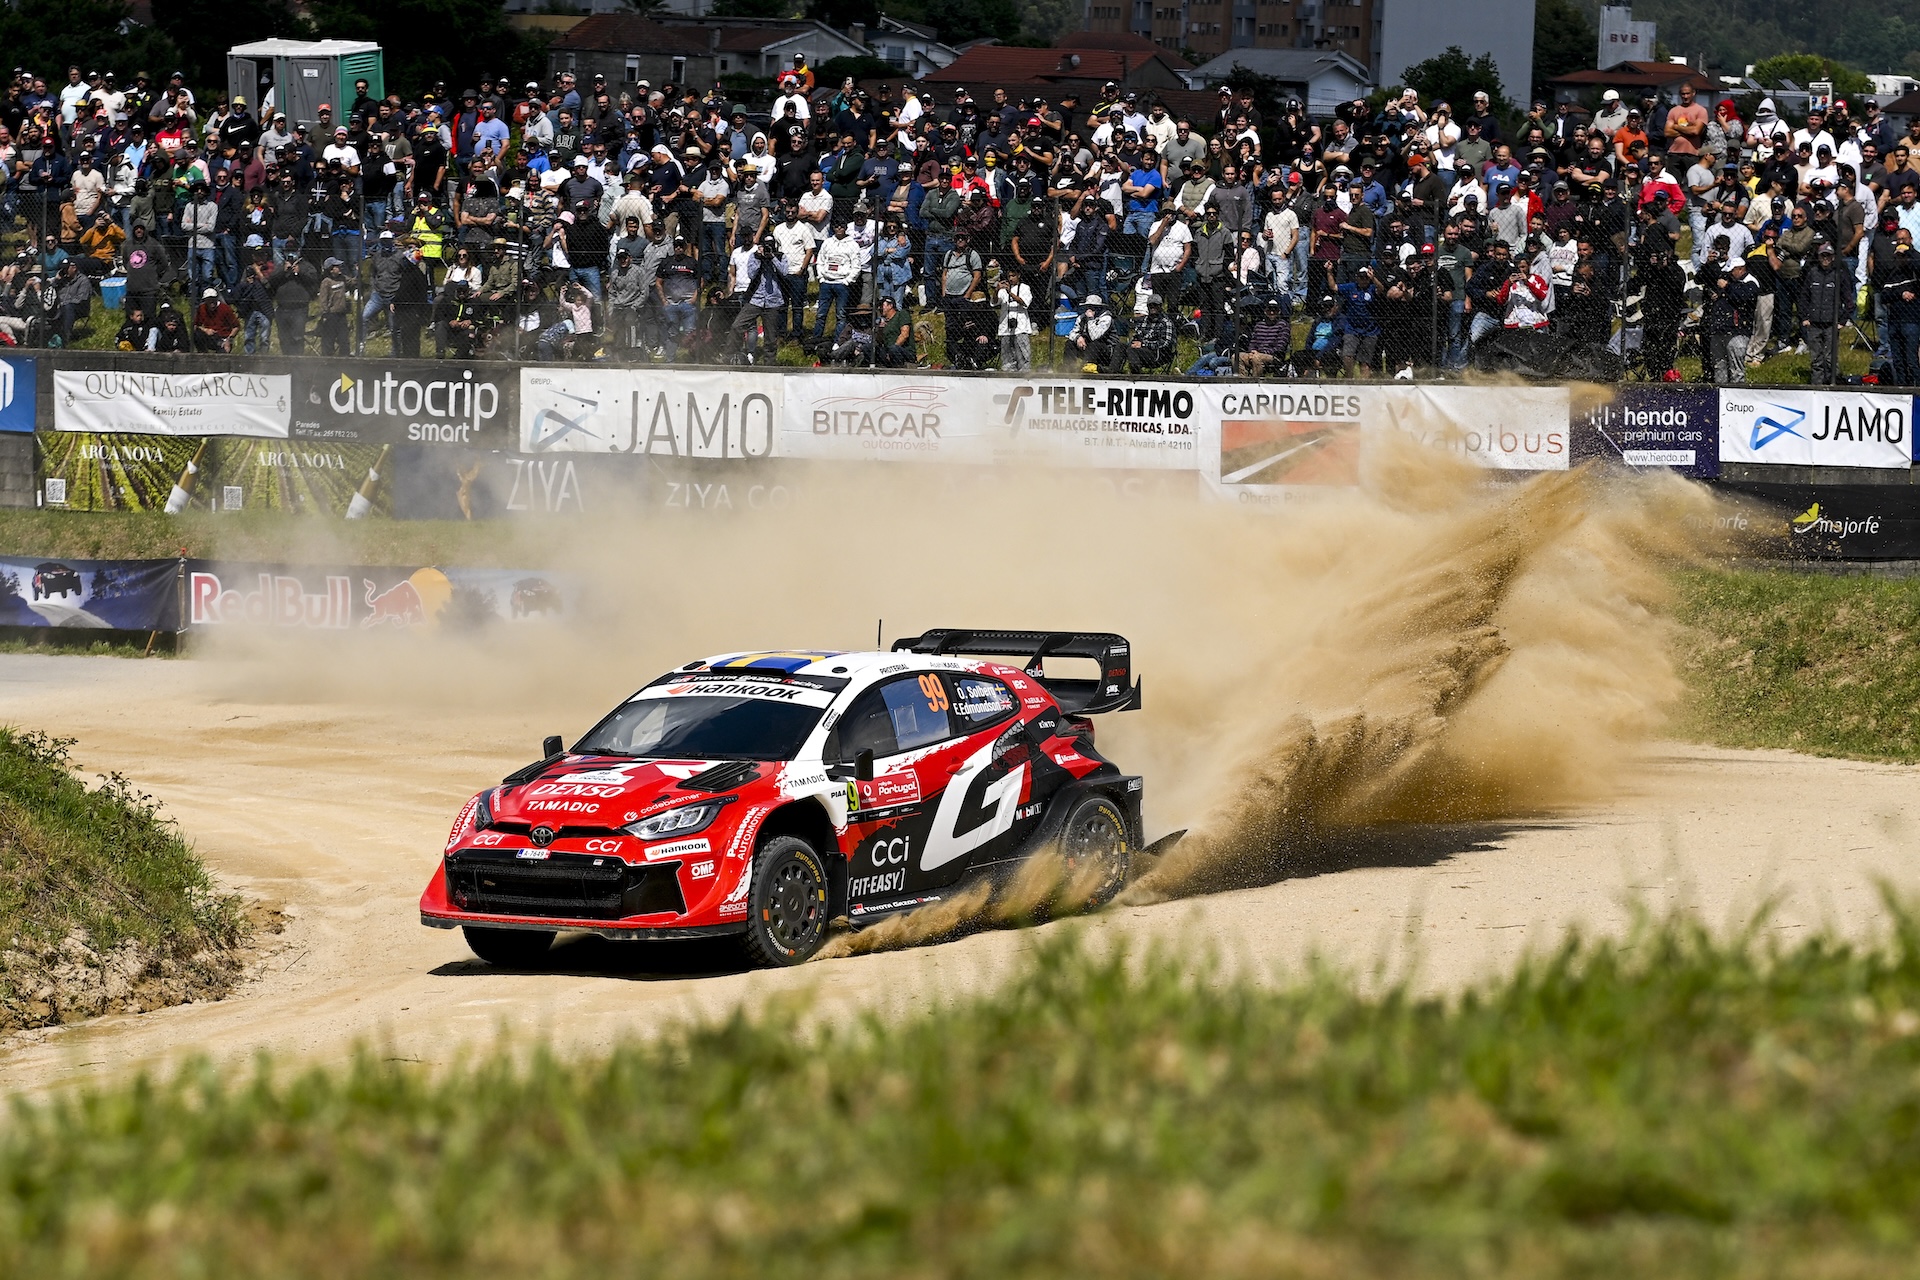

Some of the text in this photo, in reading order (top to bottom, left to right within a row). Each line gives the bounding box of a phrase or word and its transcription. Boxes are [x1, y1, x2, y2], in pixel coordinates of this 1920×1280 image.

[1610, 33, 1639, 43] BVB
[1491, 174, 1510, 182] FILA
[199, 375, 269, 398] ARCAS
[329, 369, 499, 431] autocrip
[1037, 386, 1194, 419] TELE-RITMO
[1221, 393, 1361, 417] CARIDADES
[1725, 400, 1755, 414] Grupo
[153, 406, 203, 418] Family Estates
[1624, 405, 1687, 426] hendo
[408, 422, 470, 443] smart
[608, 390, 774, 458] JAMO
[812, 410, 942, 439] BITACAR
[1028, 418, 1193, 435] INSTALAÇÕES ELÉCTRICAS, LDA.
[1811, 405, 1904, 444] JAMO
[862, 439, 939, 452] automóveis
[1129, 438, 1156, 449] Alvará
[1168, 440, 1192, 451] 42110
[1624, 430, 1703, 444] premium cars
[121, 445, 163, 462] NOVA
[1626, 451, 1689, 464] www.hendo.pt
[505, 458, 584, 513] ZIYA
[665, 482, 733, 509] ZIYA
[879, 663, 910, 675] PROTERIAL
[918, 672, 950, 713] 99
[968, 682, 997, 699] Solberg
[529, 783, 626, 799] DENSO
[830, 789, 847, 799] PIAA
[878, 780, 918, 796] Portugal
[526, 800, 601, 814] TAMADIC
[640, 792, 703, 815] codebeamer
[726, 806, 760, 858] Panasonic
[737, 806, 771, 861] AUTOMOTIVE
[691, 862, 715, 877] OMP
[864, 902, 893, 913] TOYOTA
